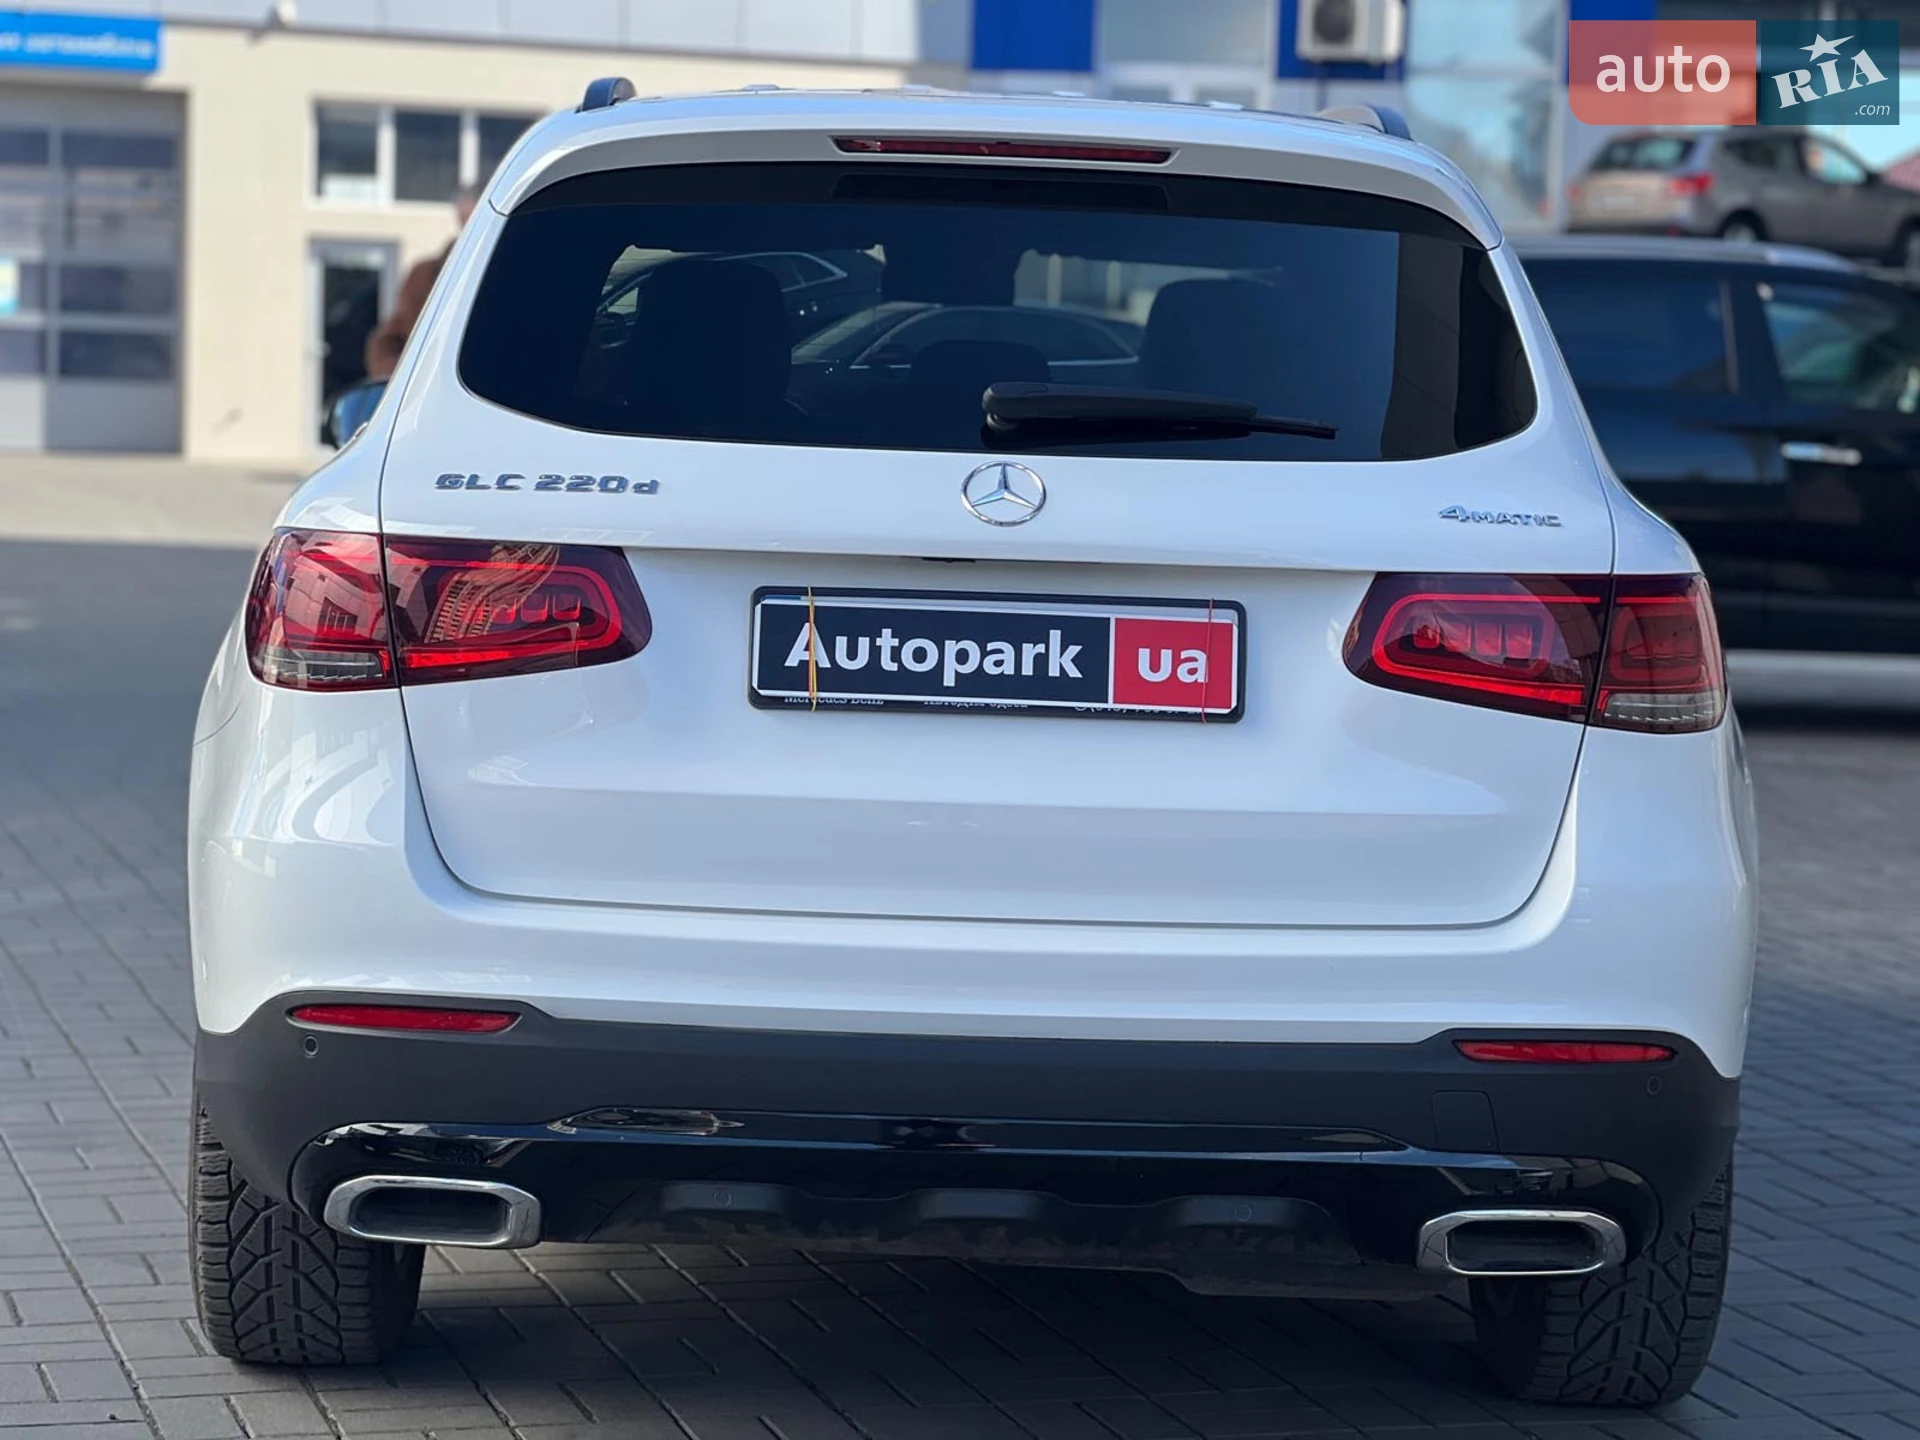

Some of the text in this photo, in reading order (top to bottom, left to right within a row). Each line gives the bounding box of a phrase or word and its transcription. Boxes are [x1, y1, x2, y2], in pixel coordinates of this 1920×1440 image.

[435, 473, 660, 495] GLC 220d
[1438, 505, 1563, 527] 4MATIC
[783, 621, 1208, 687] Autopark ua
